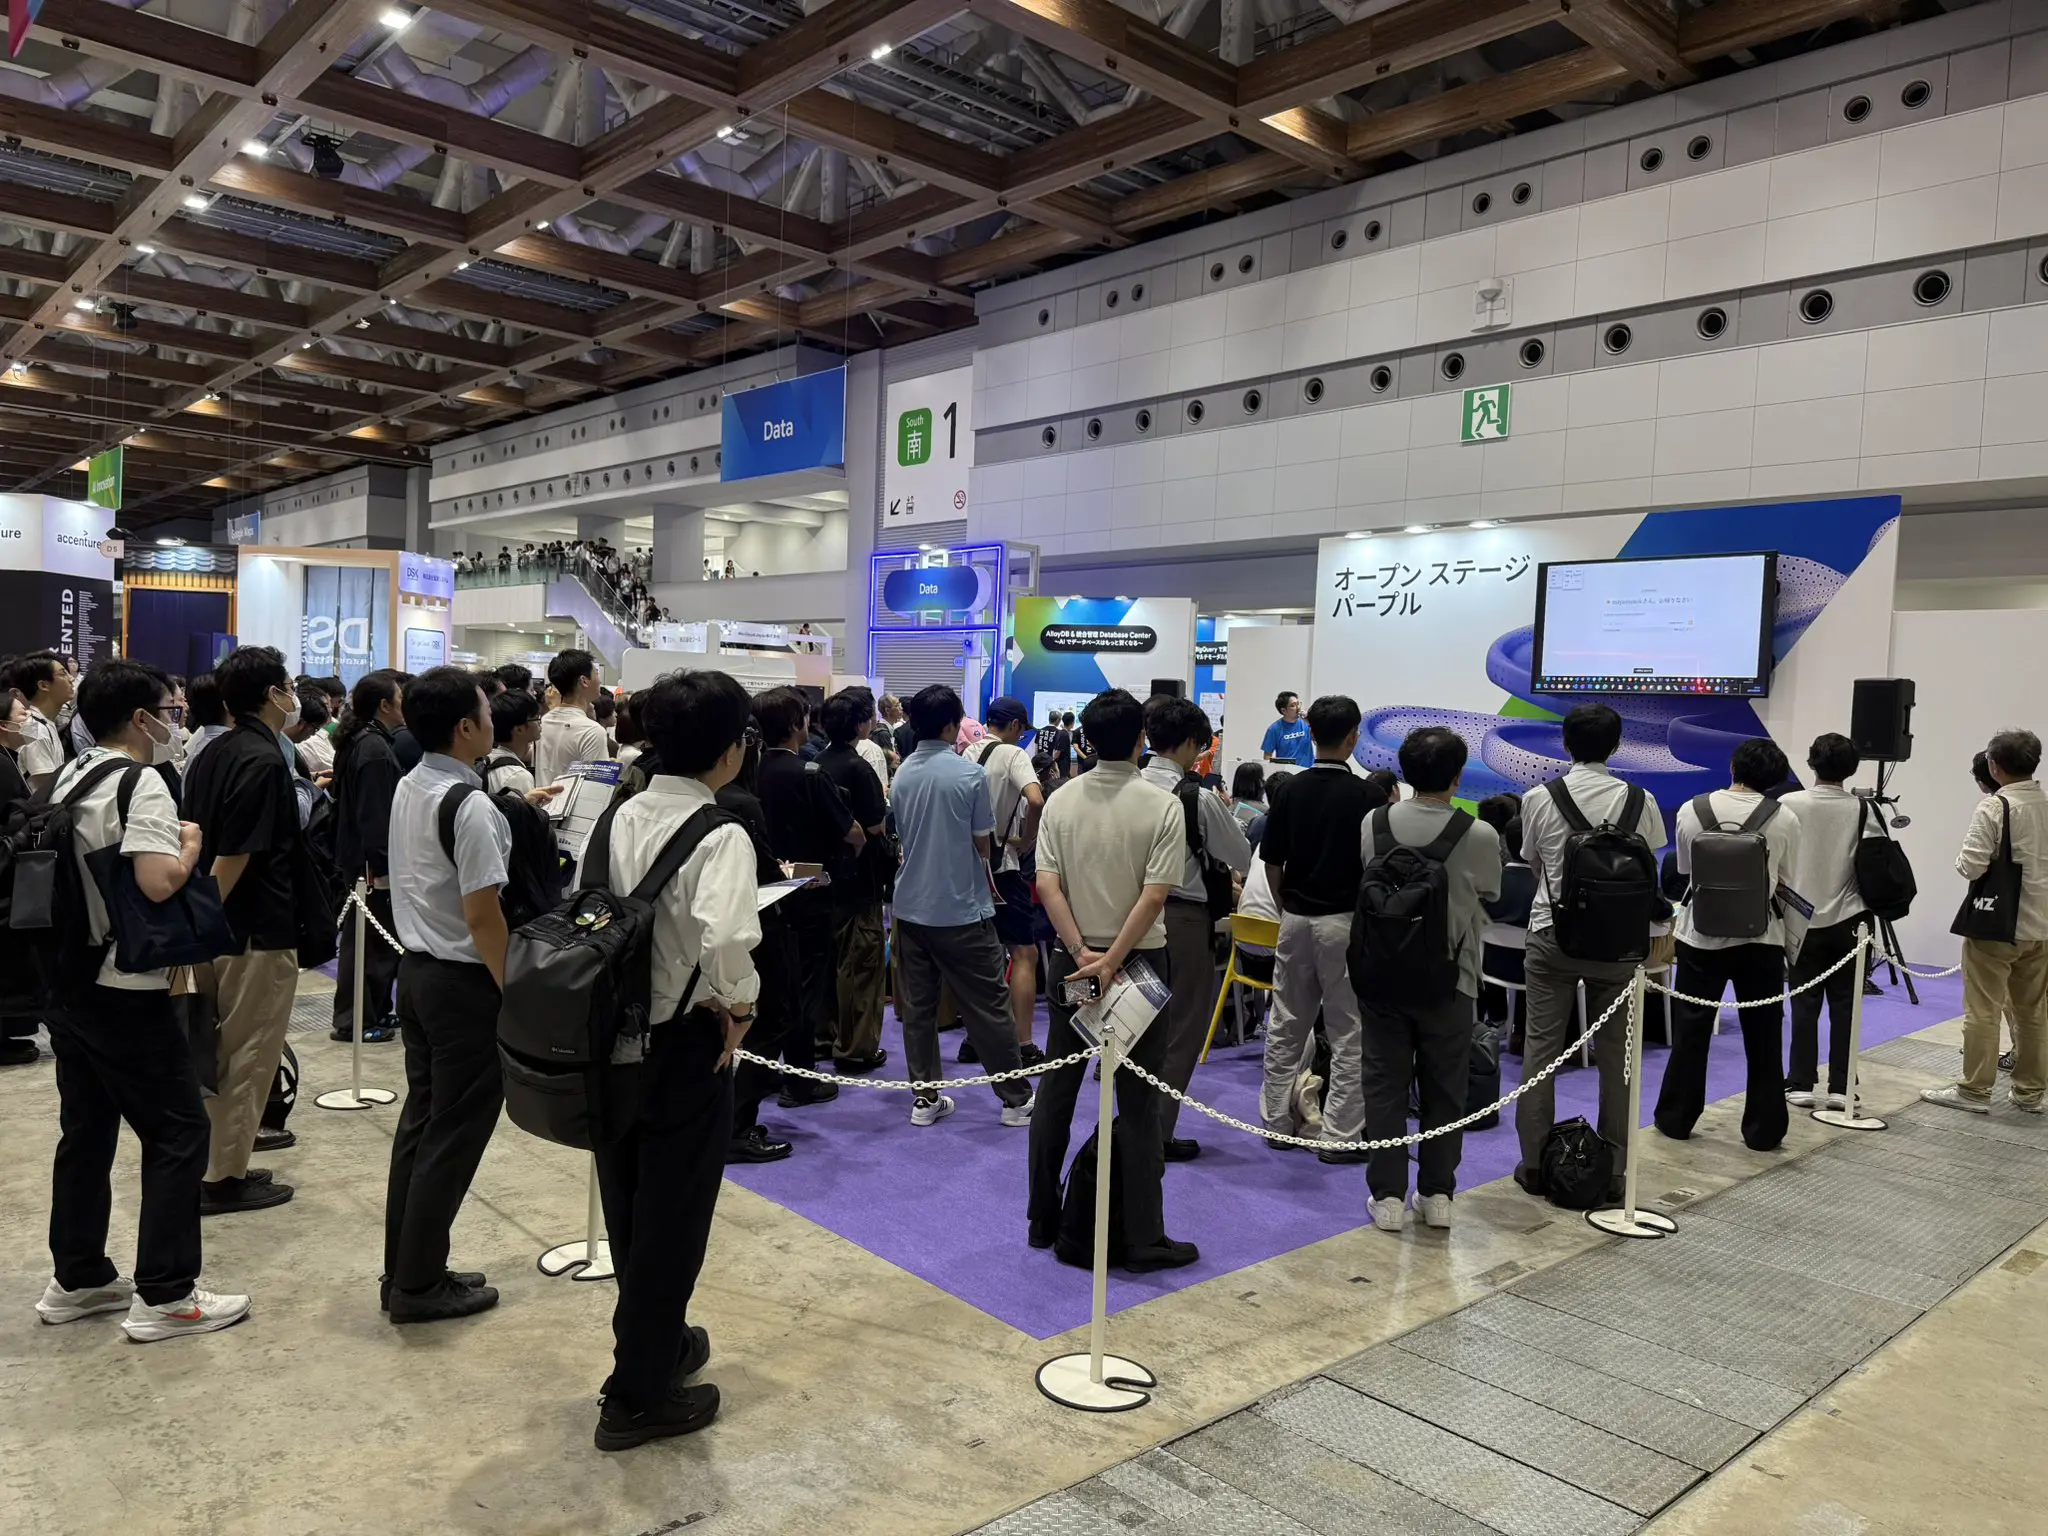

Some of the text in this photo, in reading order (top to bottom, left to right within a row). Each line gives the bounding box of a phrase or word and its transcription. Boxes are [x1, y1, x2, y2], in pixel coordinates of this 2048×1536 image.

[763, 419, 794, 441] Data
[906, 415, 924, 428] South
[943, 401, 957, 459] 1
[907, 430, 922, 460] 南
[0, 529, 21, 539] ure
[57, 533, 101, 549] accenture
[1334, 562, 1422, 590] オープン
[1428, 554, 1531, 586] ステージ
[919, 583, 938, 595] Data
[1332, 590, 1422, 617] パープル
[1045, 630, 1069, 639] AlloyDB
[1129, 631, 1152, 639] Center
